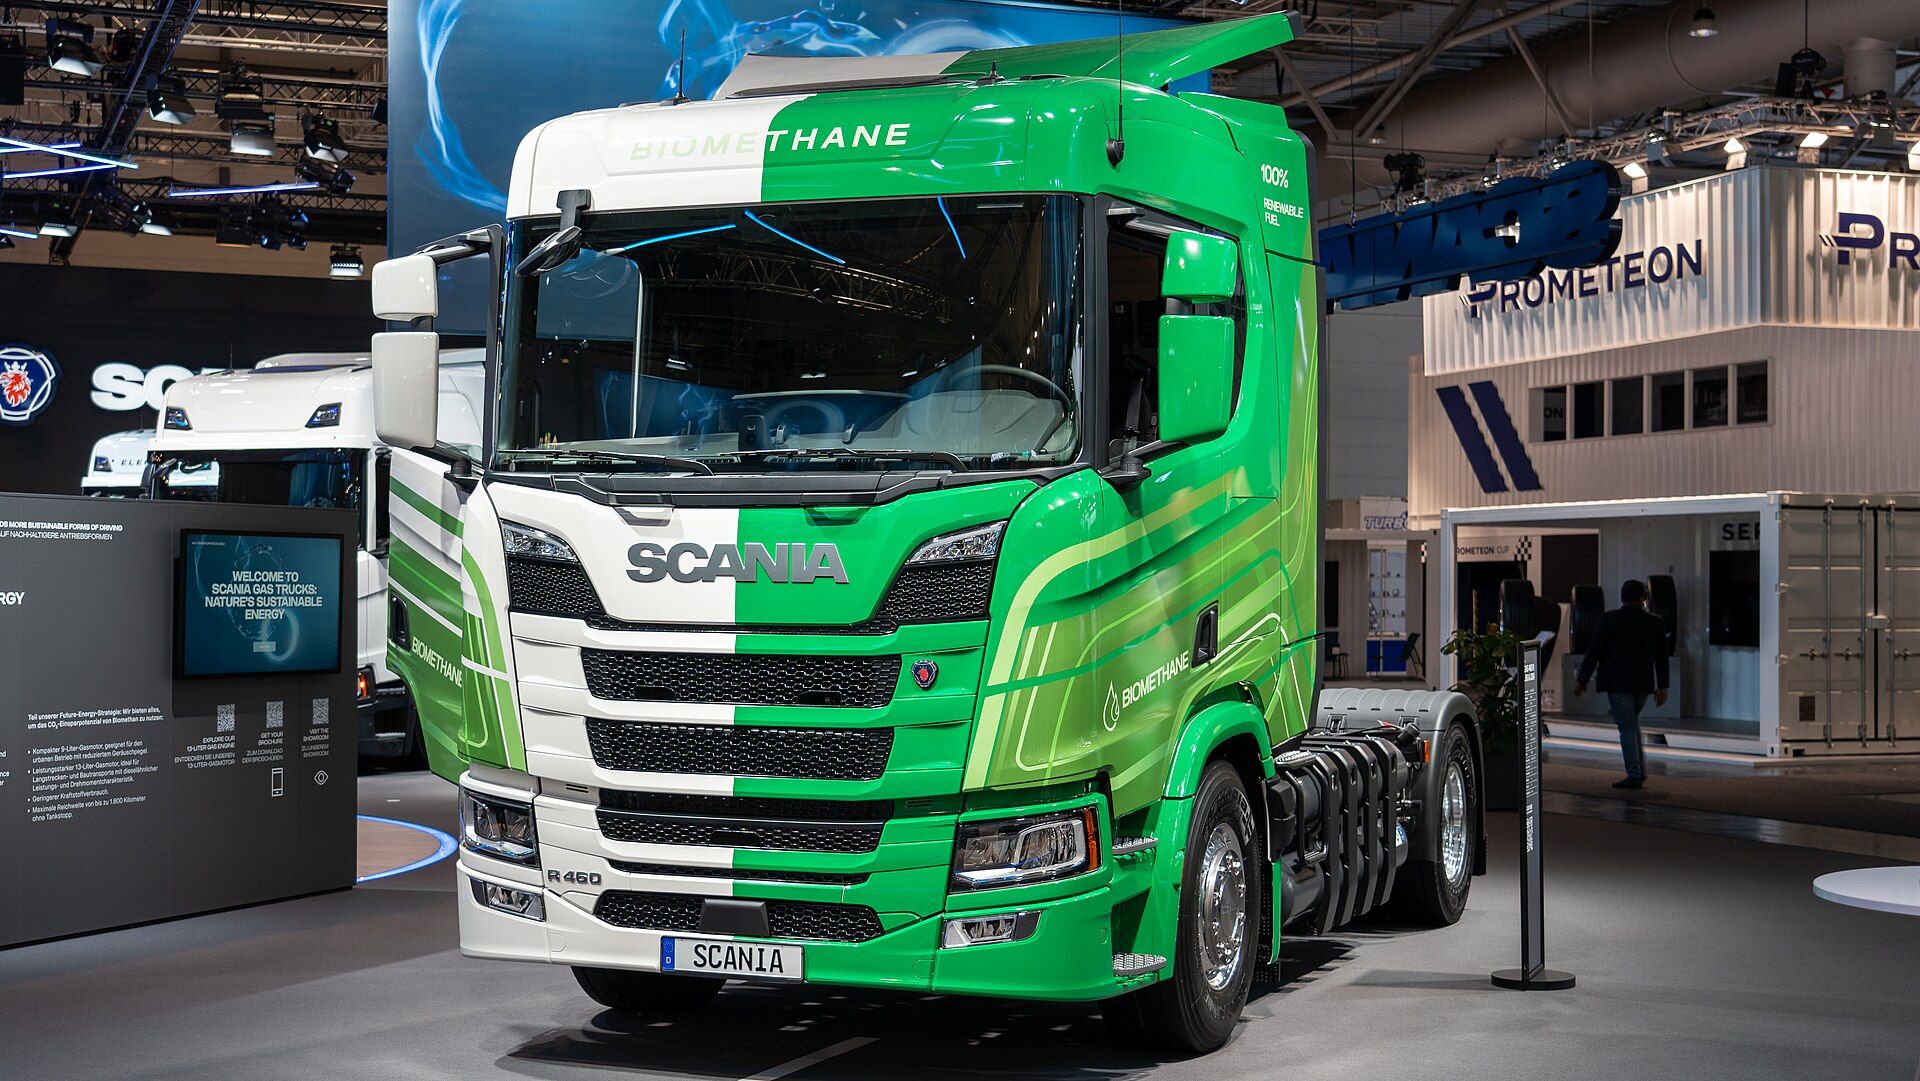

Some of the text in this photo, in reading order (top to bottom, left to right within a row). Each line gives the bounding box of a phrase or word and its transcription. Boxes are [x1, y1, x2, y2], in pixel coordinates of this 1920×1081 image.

[630, 123, 911, 160] BIOMETHANE
[1261, 164, 1289, 189] 100%
[1264, 197, 1304, 219] RENEWABLE
[1265, 212, 1280, 226] FUEL
[1461, 239, 1702, 318] PROMETEON
[9, 521, 28, 529] MORE
[28, 522, 69, 530] SUSTAINABLE
[69, 523, 91, 531] FORMS
[10, 531, 59, 539] NACHHALTIGERE
[60, 533, 113, 541] ANTRIEBSFORMEN
[626, 542, 849, 584] SCANIA
[233, 571, 299, 582] WELCOME TO
[212, 584, 318, 595] SCANIA GAS TRUCKS:
[205, 596, 323, 608] NATURE'S SUSTAINABLE
[245, 609, 285, 620] ENERGY
[411, 636, 462, 688] BIOMETHANE
[1122, 650, 1189, 708] BIOMETHANE
[113, 716, 139, 724] Biomethan
[203, 736, 225, 744] EXPLORE
[258, 738, 284, 746] BROCHURE
[33, 747, 60, 755] Kompakter
[258, 748, 284, 756] DOWNLOAD
[175, 755, 205, 763] ENTDECKEN
[60, 781, 70, 789] und
[548, 869, 602, 885] R 460
[693, 943, 784, 973] SCANIA
